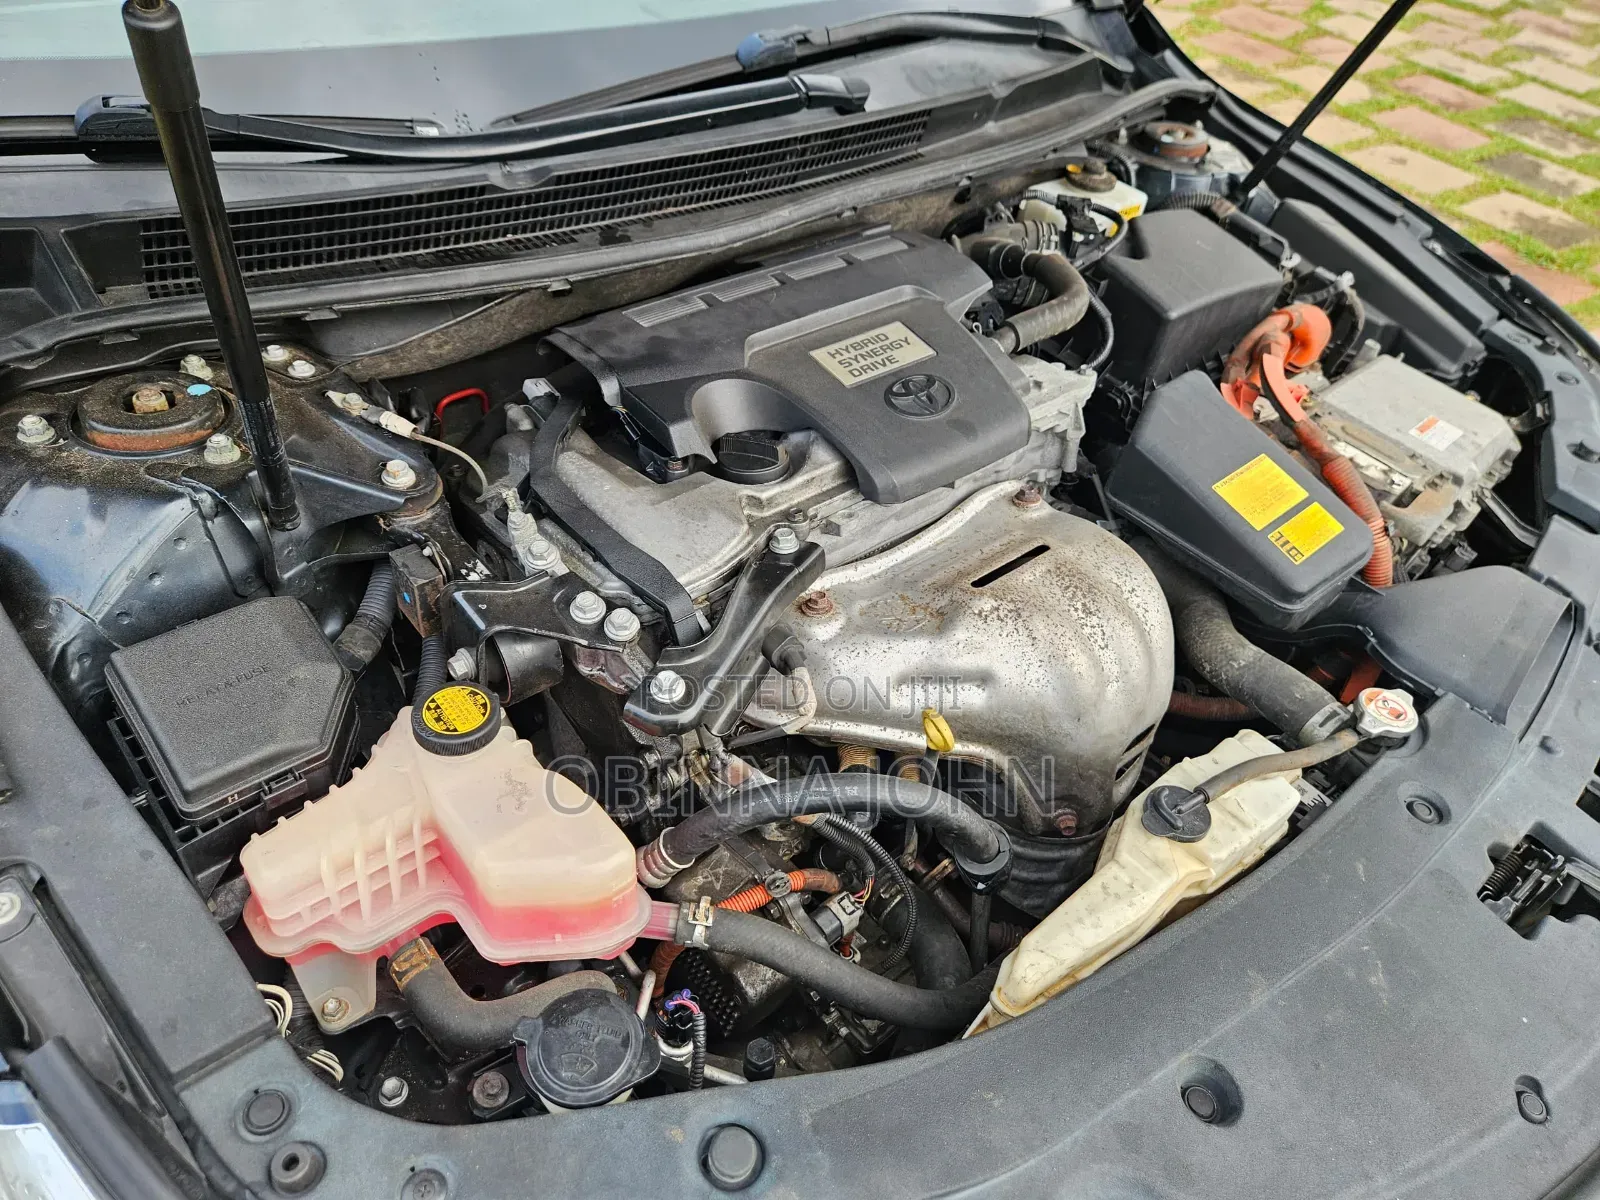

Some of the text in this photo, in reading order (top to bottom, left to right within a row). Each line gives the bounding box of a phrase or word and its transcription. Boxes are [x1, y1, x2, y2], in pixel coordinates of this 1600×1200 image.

[827, 333, 889, 360] HYBRID
[837, 336, 911, 369] SYNERGY
[847, 354, 900, 378] DRIVE
[236, 662, 272, 683] FUSE
[559, 1015, 594, 1030] WASHER
